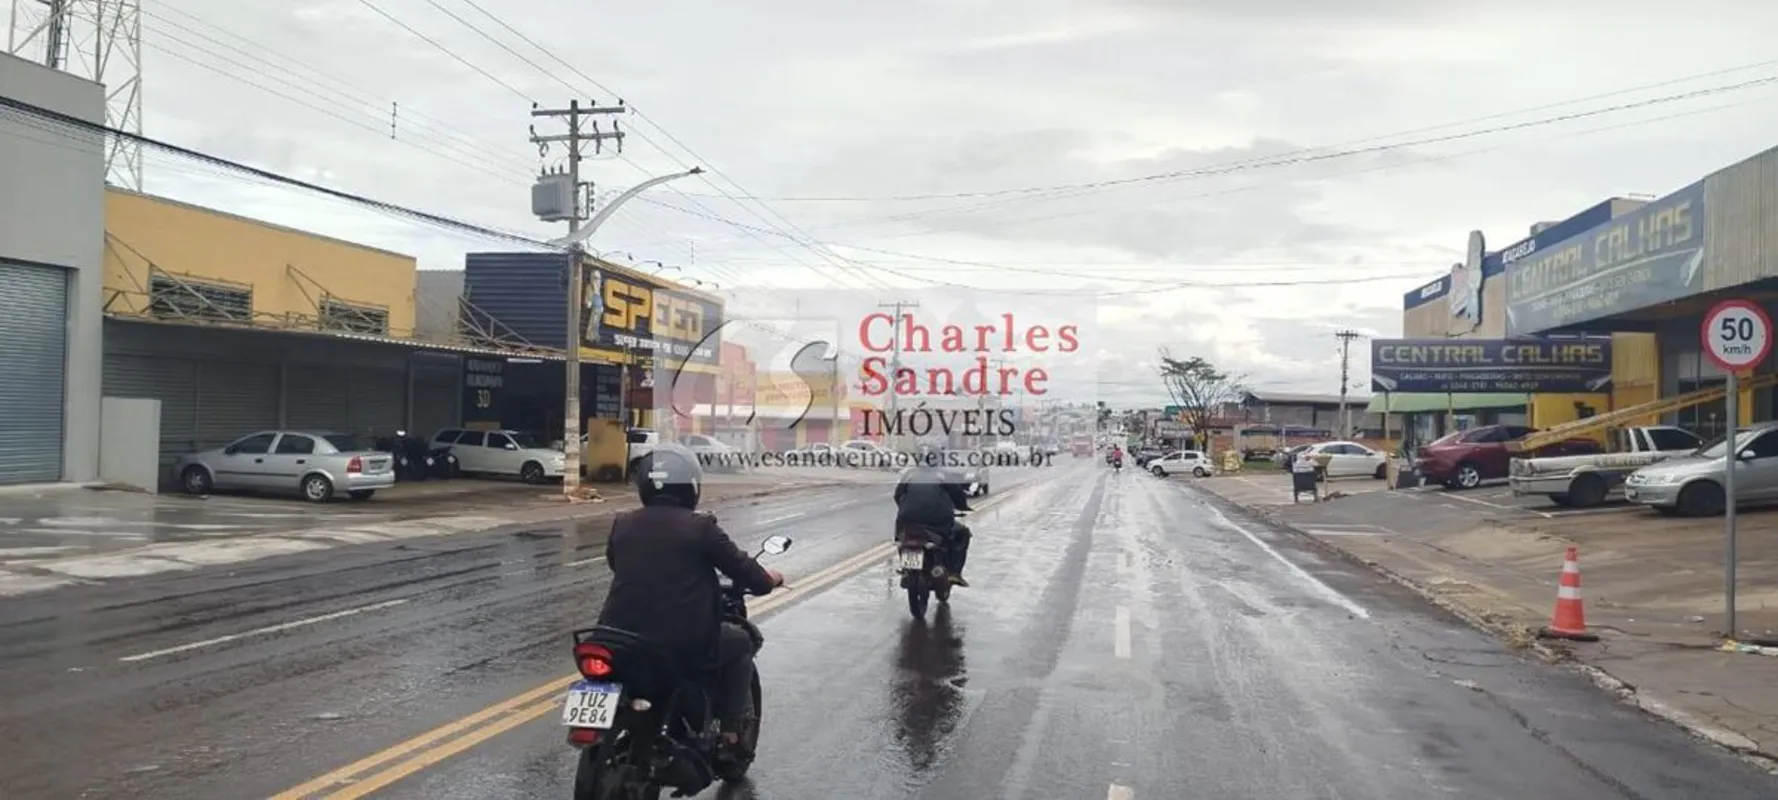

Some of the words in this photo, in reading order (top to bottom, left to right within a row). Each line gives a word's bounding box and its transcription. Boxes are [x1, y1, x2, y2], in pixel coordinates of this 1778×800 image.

[1512, 244, 1588, 300] CENTRAL
[1594, 202, 1693, 268] CALHAS
[603, 278, 703, 342] SPEED
[1721, 317, 1754, 341] 50
[1379, 345, 1493, 363] CENTRAL
[1501, 345, 1604, 363] CALHAS
[1723, 344, 1752, 355] km/h
[580, 692, 608, 708] TUZ
[570, 707, 607, 723] 9E84
